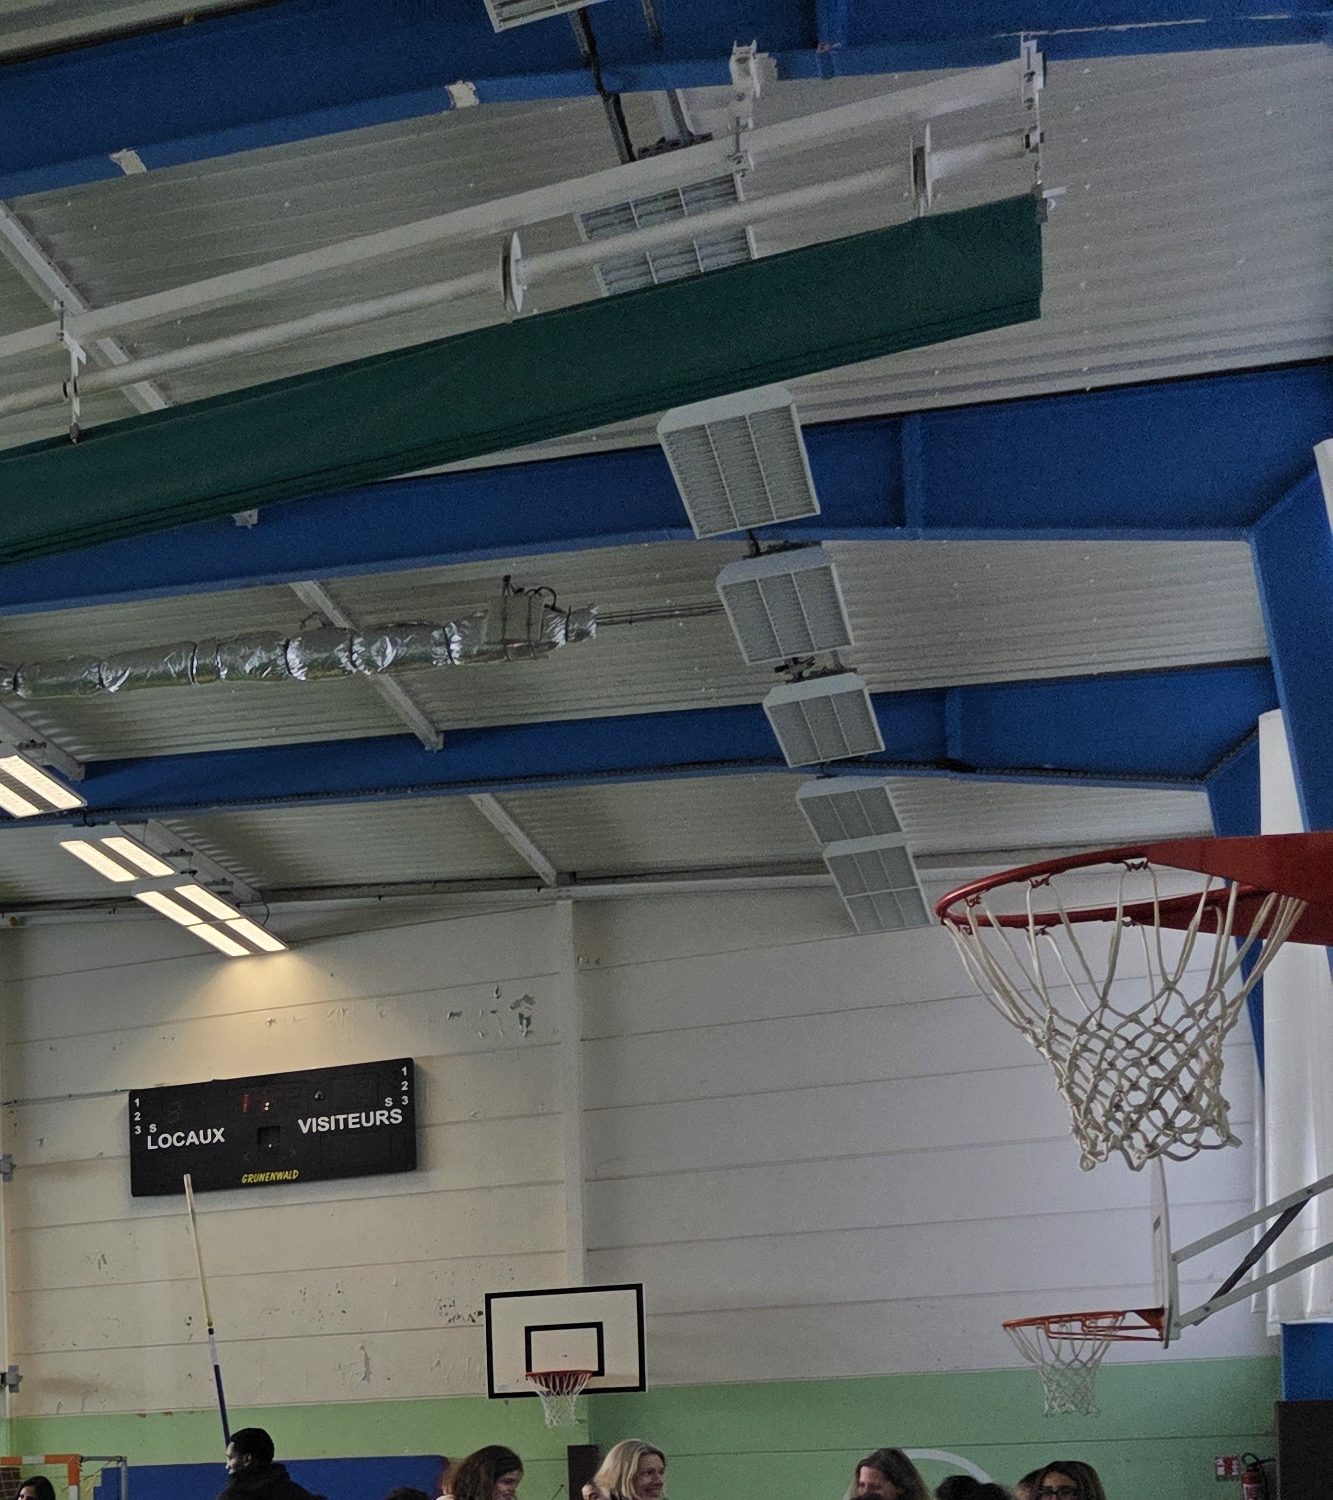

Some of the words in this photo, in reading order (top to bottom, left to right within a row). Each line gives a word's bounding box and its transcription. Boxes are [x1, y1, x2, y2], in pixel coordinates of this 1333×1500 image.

[401, 1067, 407, 1076] 1
[401, 1081, 408, 1091] 2
[134, 1098, 139, 1107] 1
[401, 1096, 409, 1105] 3
[134, 1112, 141, 1121] 2
[298, 1109, 403, 1134] VISITEURS
[134, 1125, 141, 1134] 3
[147, 1127, 225, 1150] LOCAUX
[241, 1169, 299, 1184] GRUNENWALD
